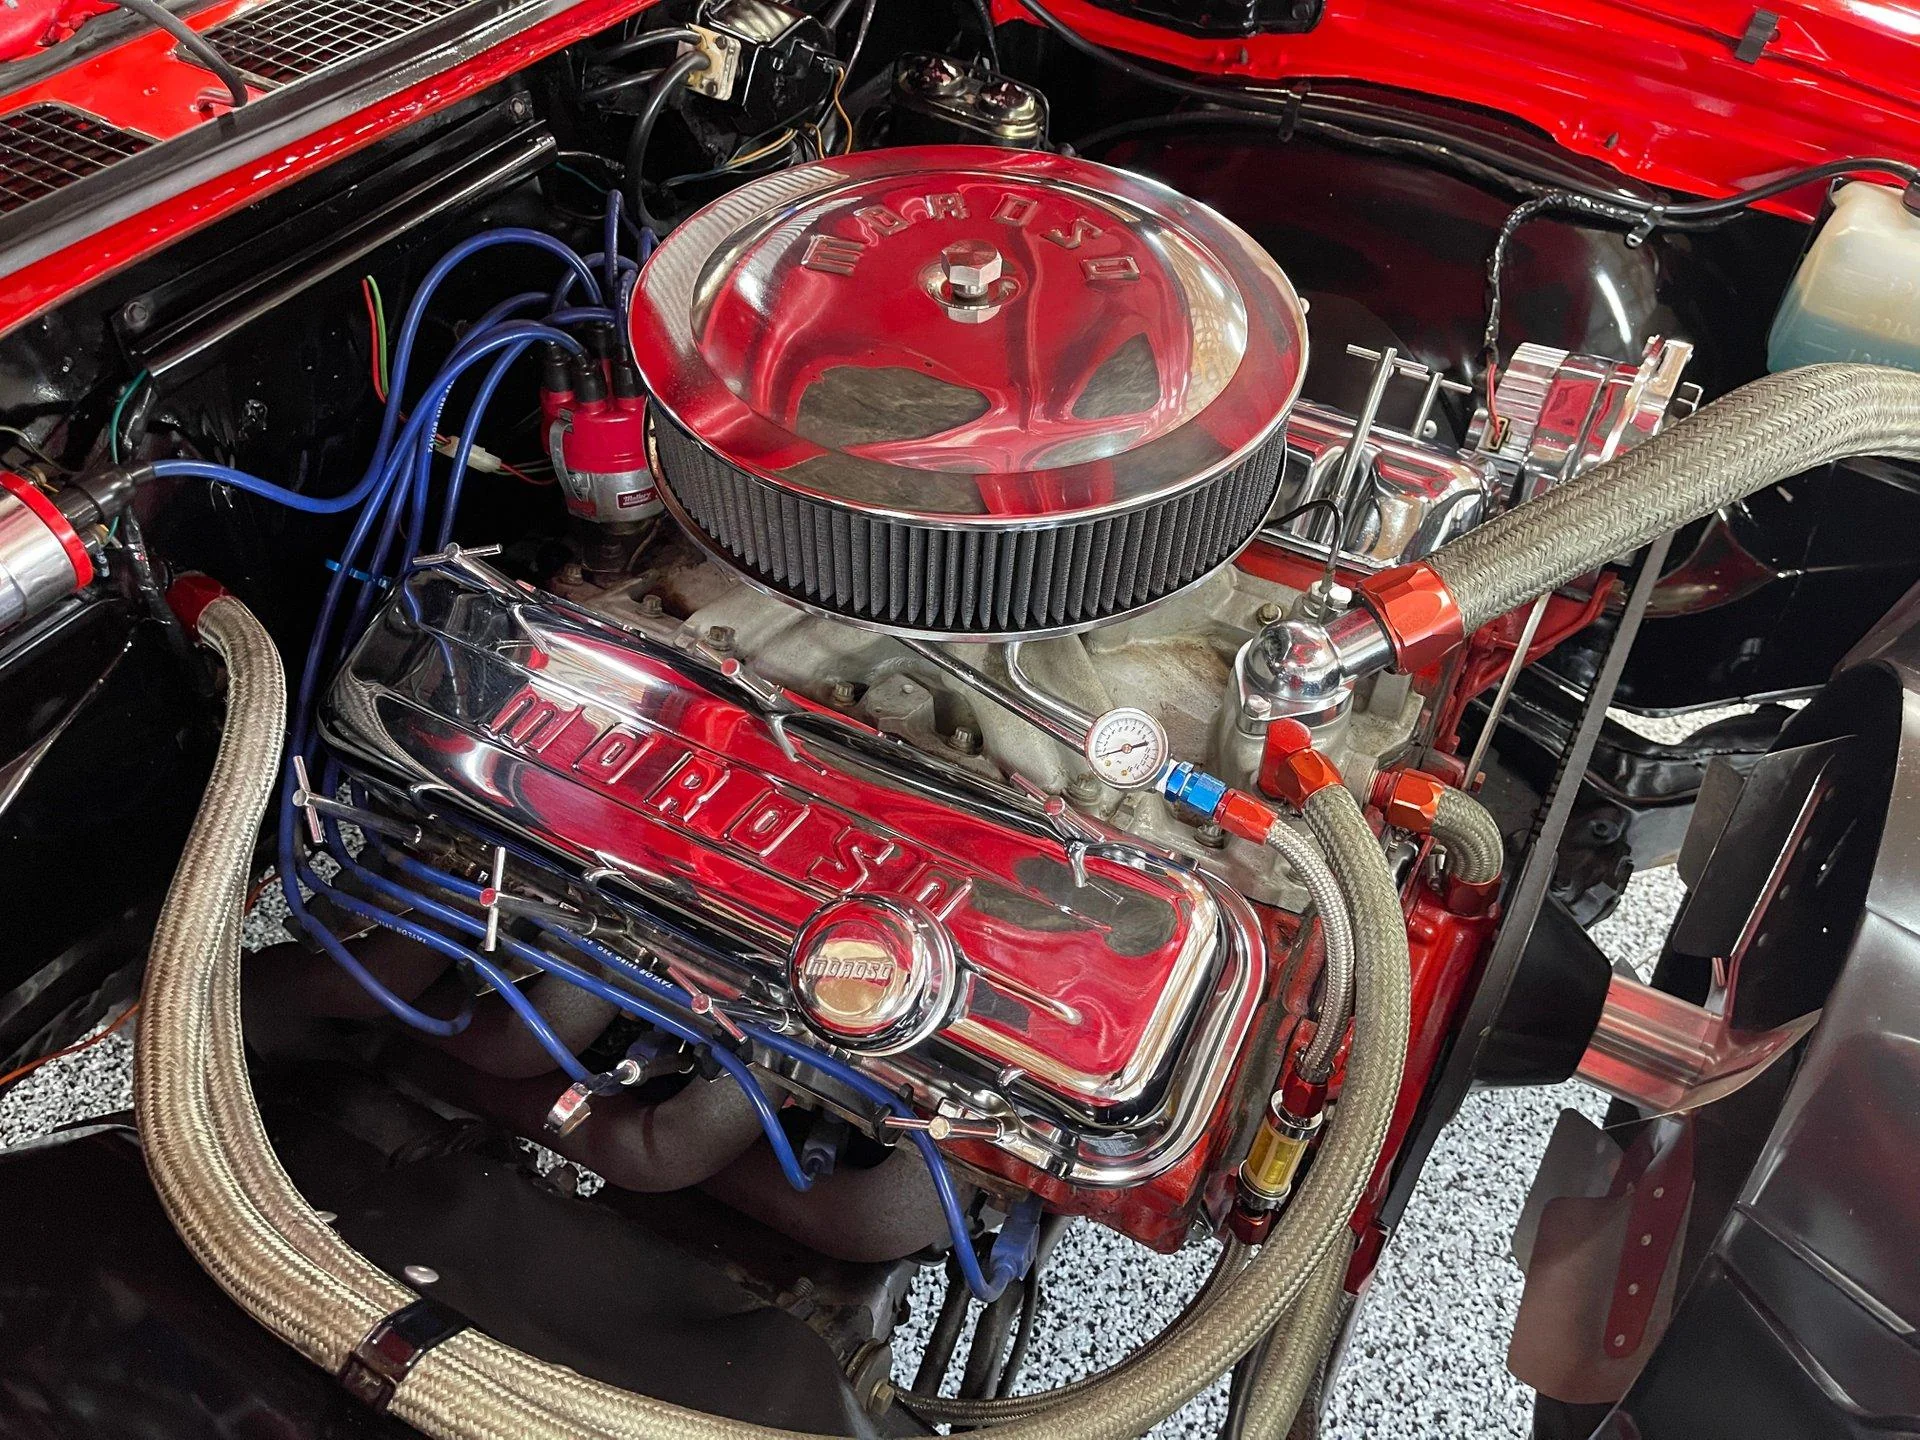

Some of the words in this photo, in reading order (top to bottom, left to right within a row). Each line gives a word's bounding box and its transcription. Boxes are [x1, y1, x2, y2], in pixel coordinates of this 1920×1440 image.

[800, 192, 1141, 283] MOROSO
[427, 421, 440, 454] TAYLOR
[478, 682, 974, 921] MOROSO
[638, 968, 675, 990] TAYLOR
[805, 955, 894, 980] MOROSO
